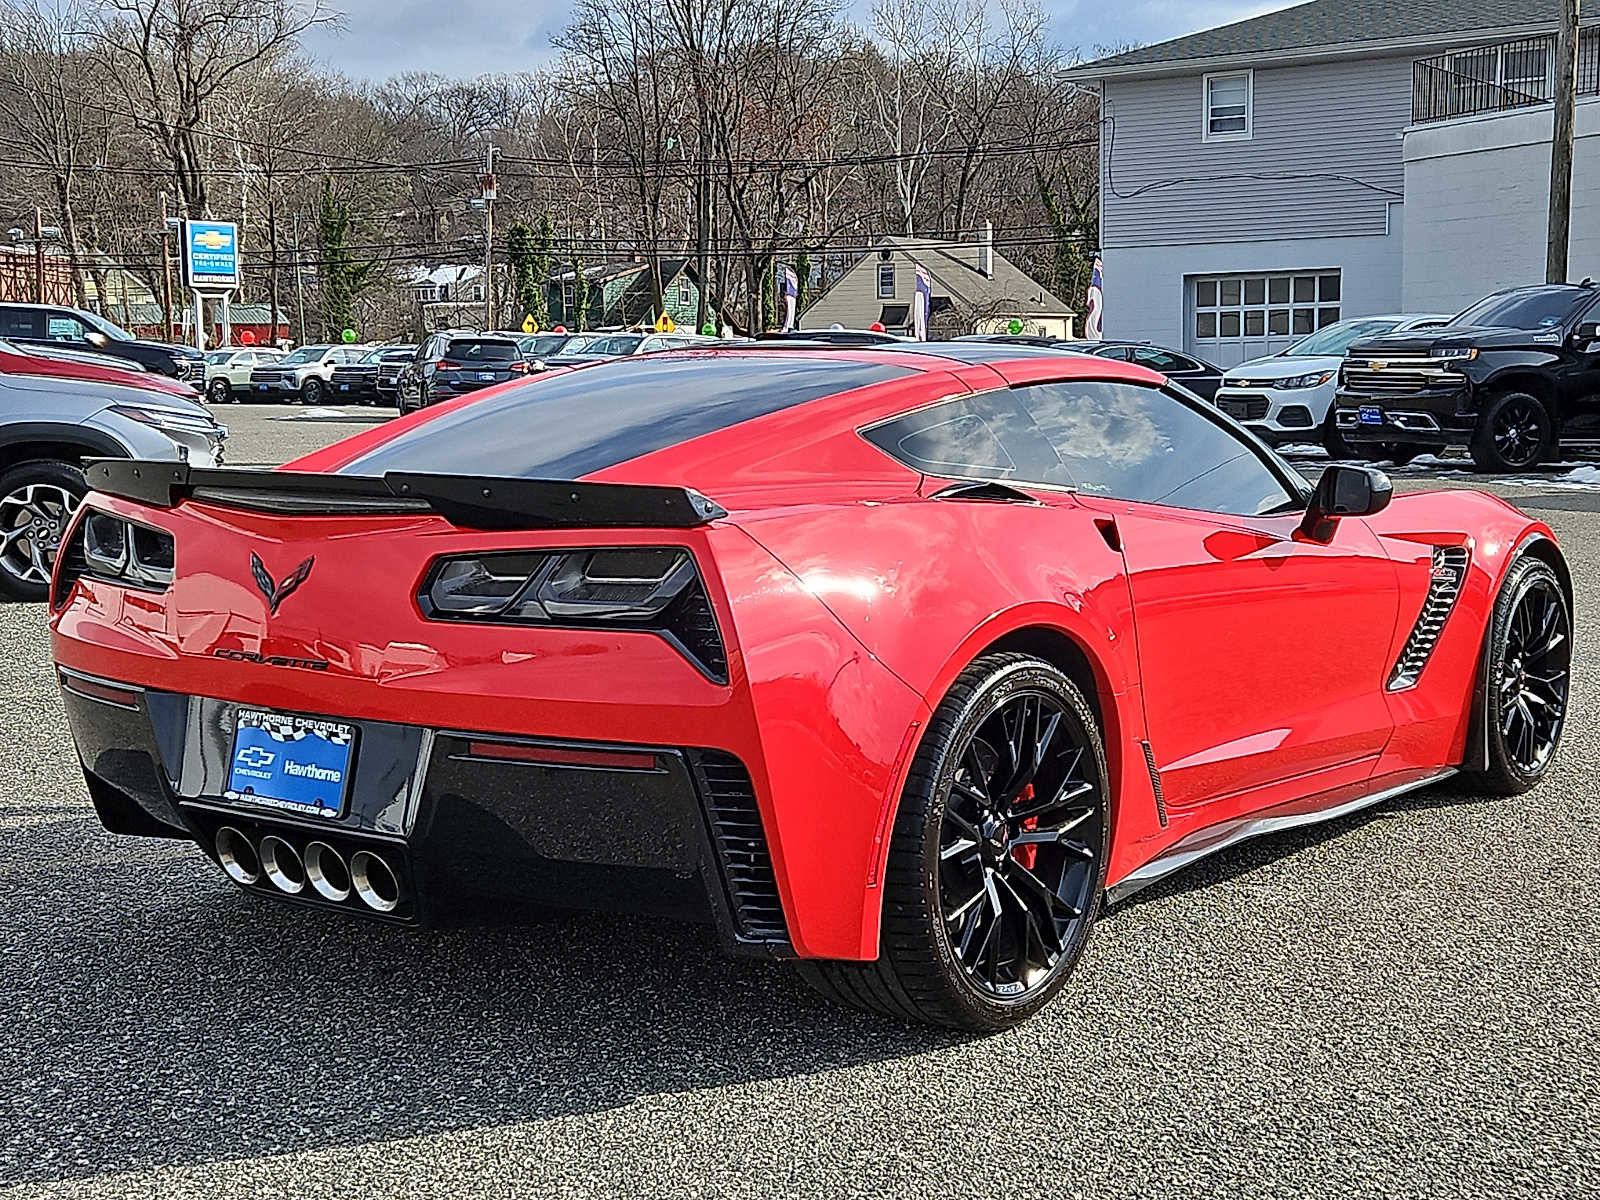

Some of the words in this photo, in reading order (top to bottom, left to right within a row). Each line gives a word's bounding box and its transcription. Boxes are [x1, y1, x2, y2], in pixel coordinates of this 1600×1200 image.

[238, 709, 294, 725] HAWTHORNE
[295, 718, 350, 734] CHEVROLET
[234, 767, 273, 779] CHEVROLET
[284, 760, 341, 782] Hawthorne
